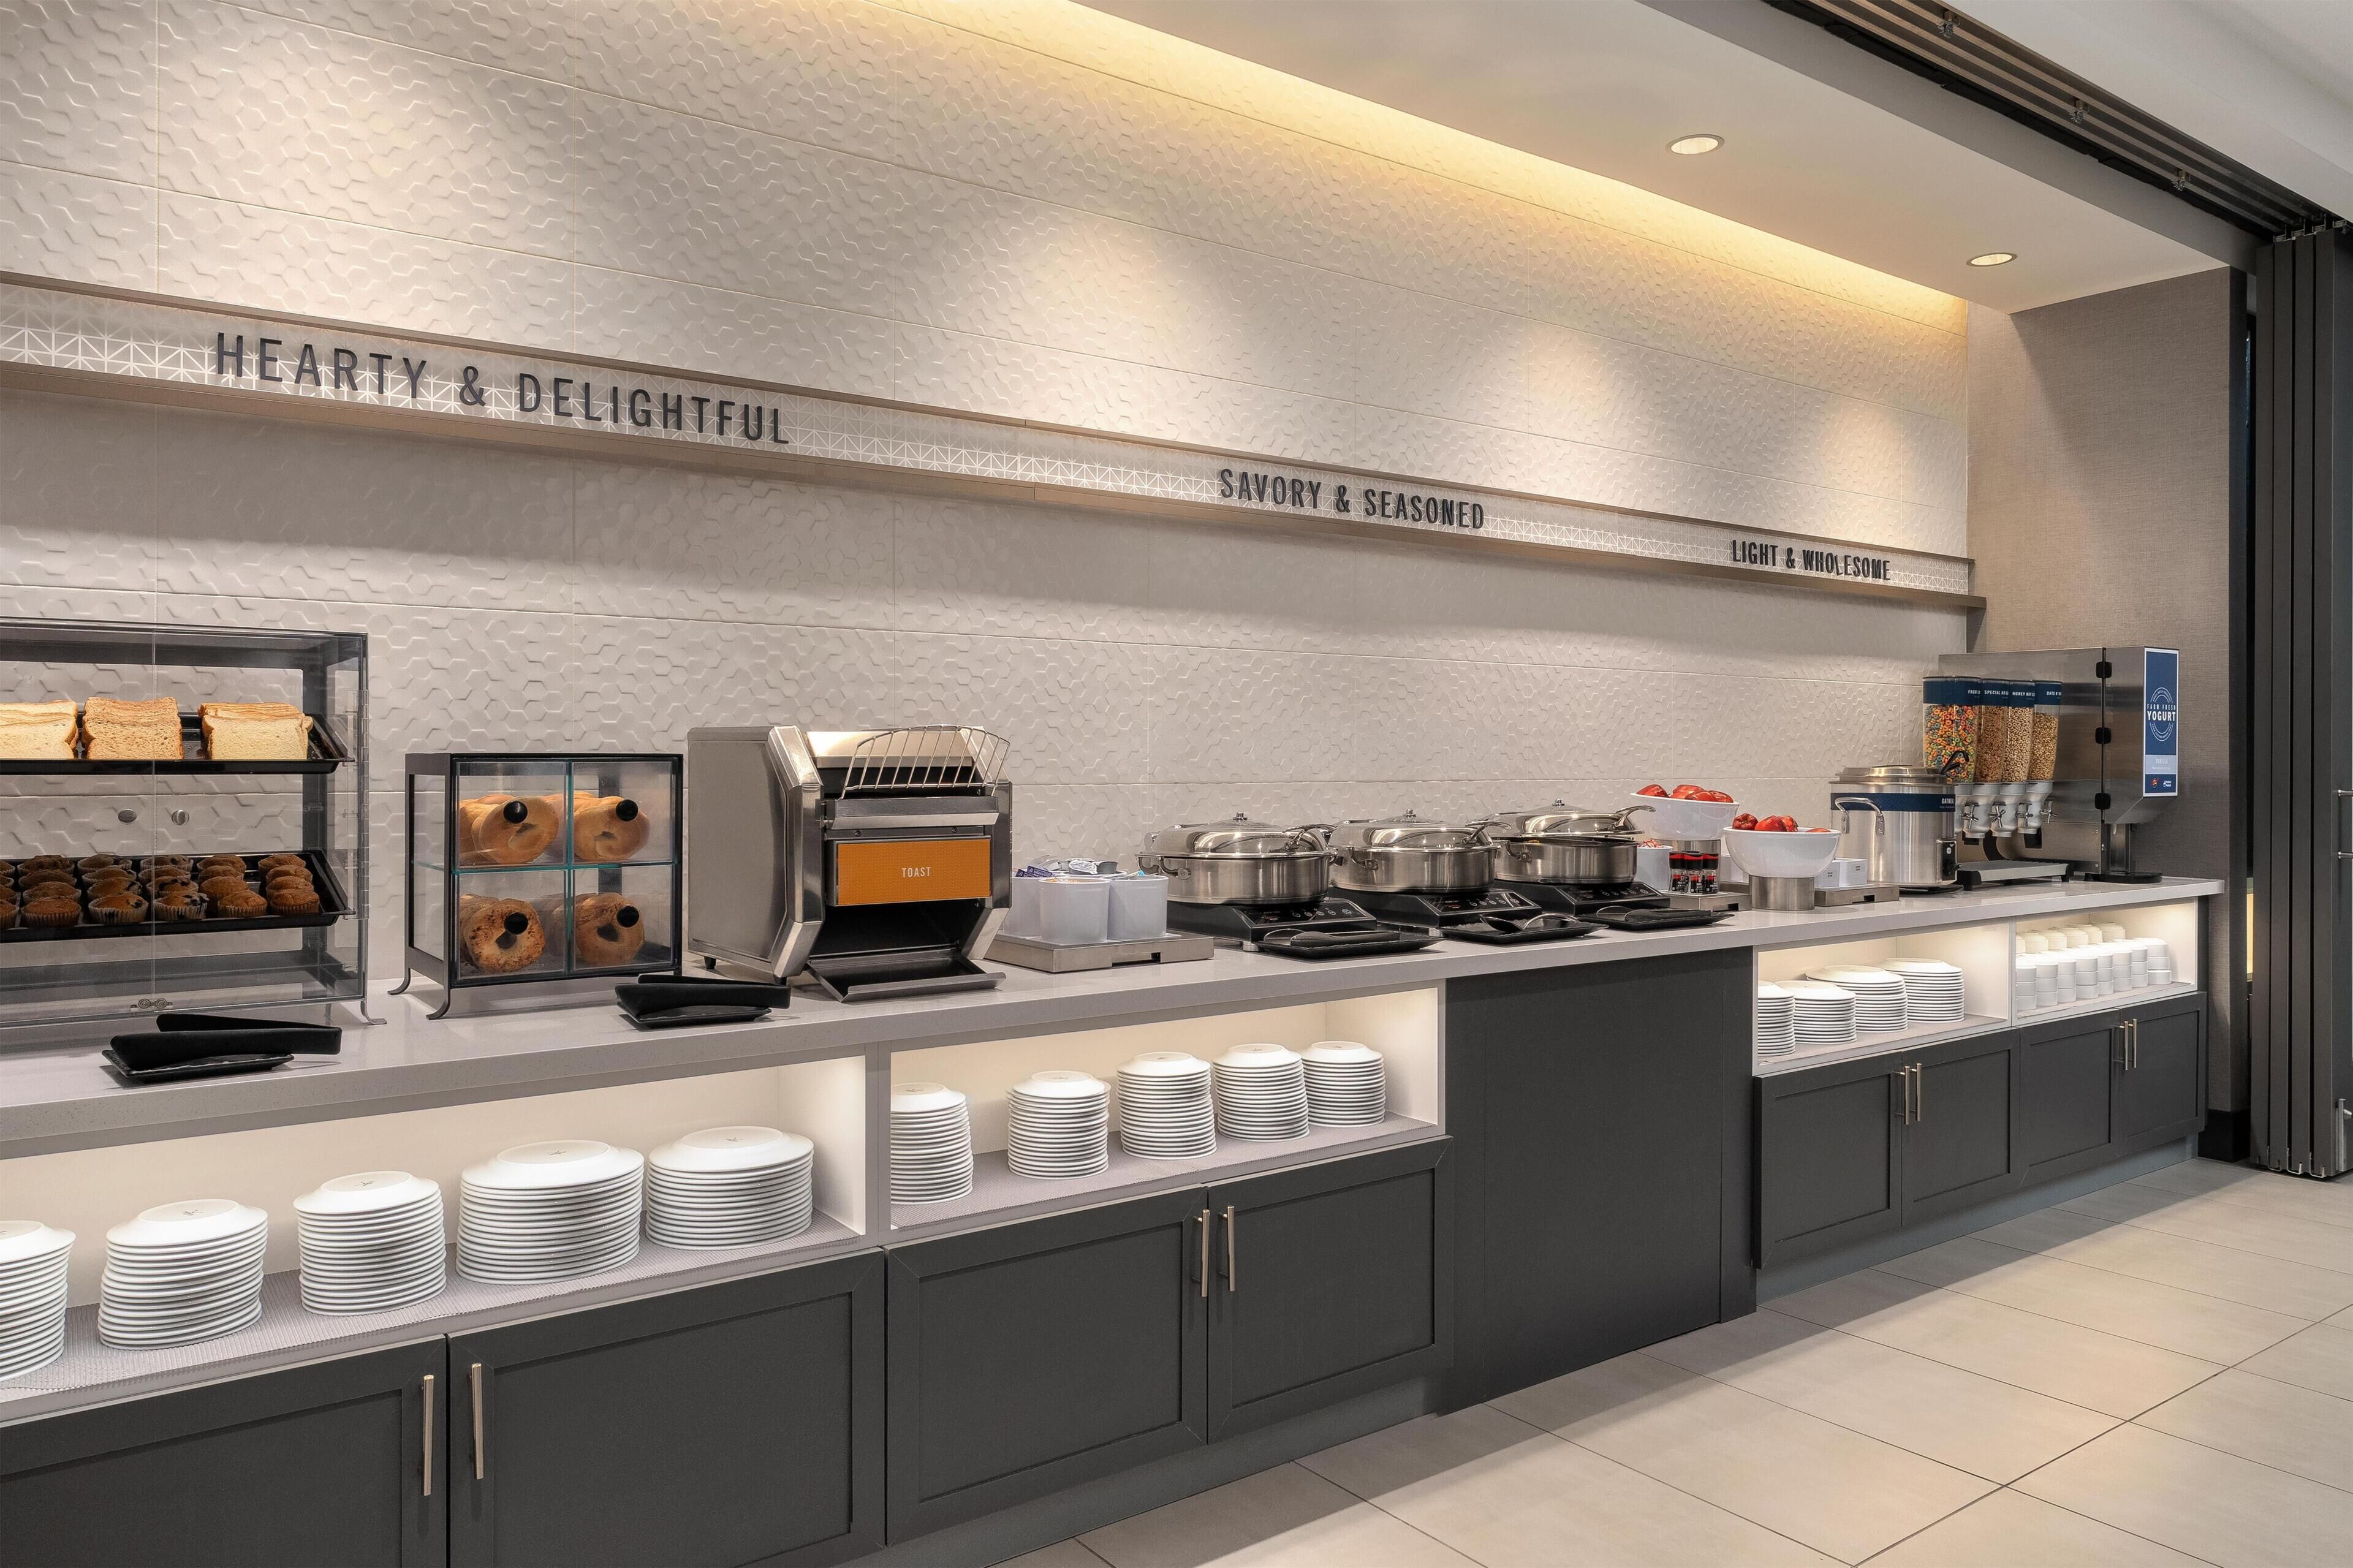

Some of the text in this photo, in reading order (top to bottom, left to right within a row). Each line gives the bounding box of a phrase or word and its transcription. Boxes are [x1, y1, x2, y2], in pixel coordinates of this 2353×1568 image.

[216, 332, 789, 445] HEARTY & DELIGHTFUL
[1220, 468, 1485, 529] SAVORY & SEASONED
[1732, 539, 1890, 580] LIGHT & WHOLESOME
[2147, 711, 2176, 721] YOGURT
[901, 866, 931, 878] TOAST
